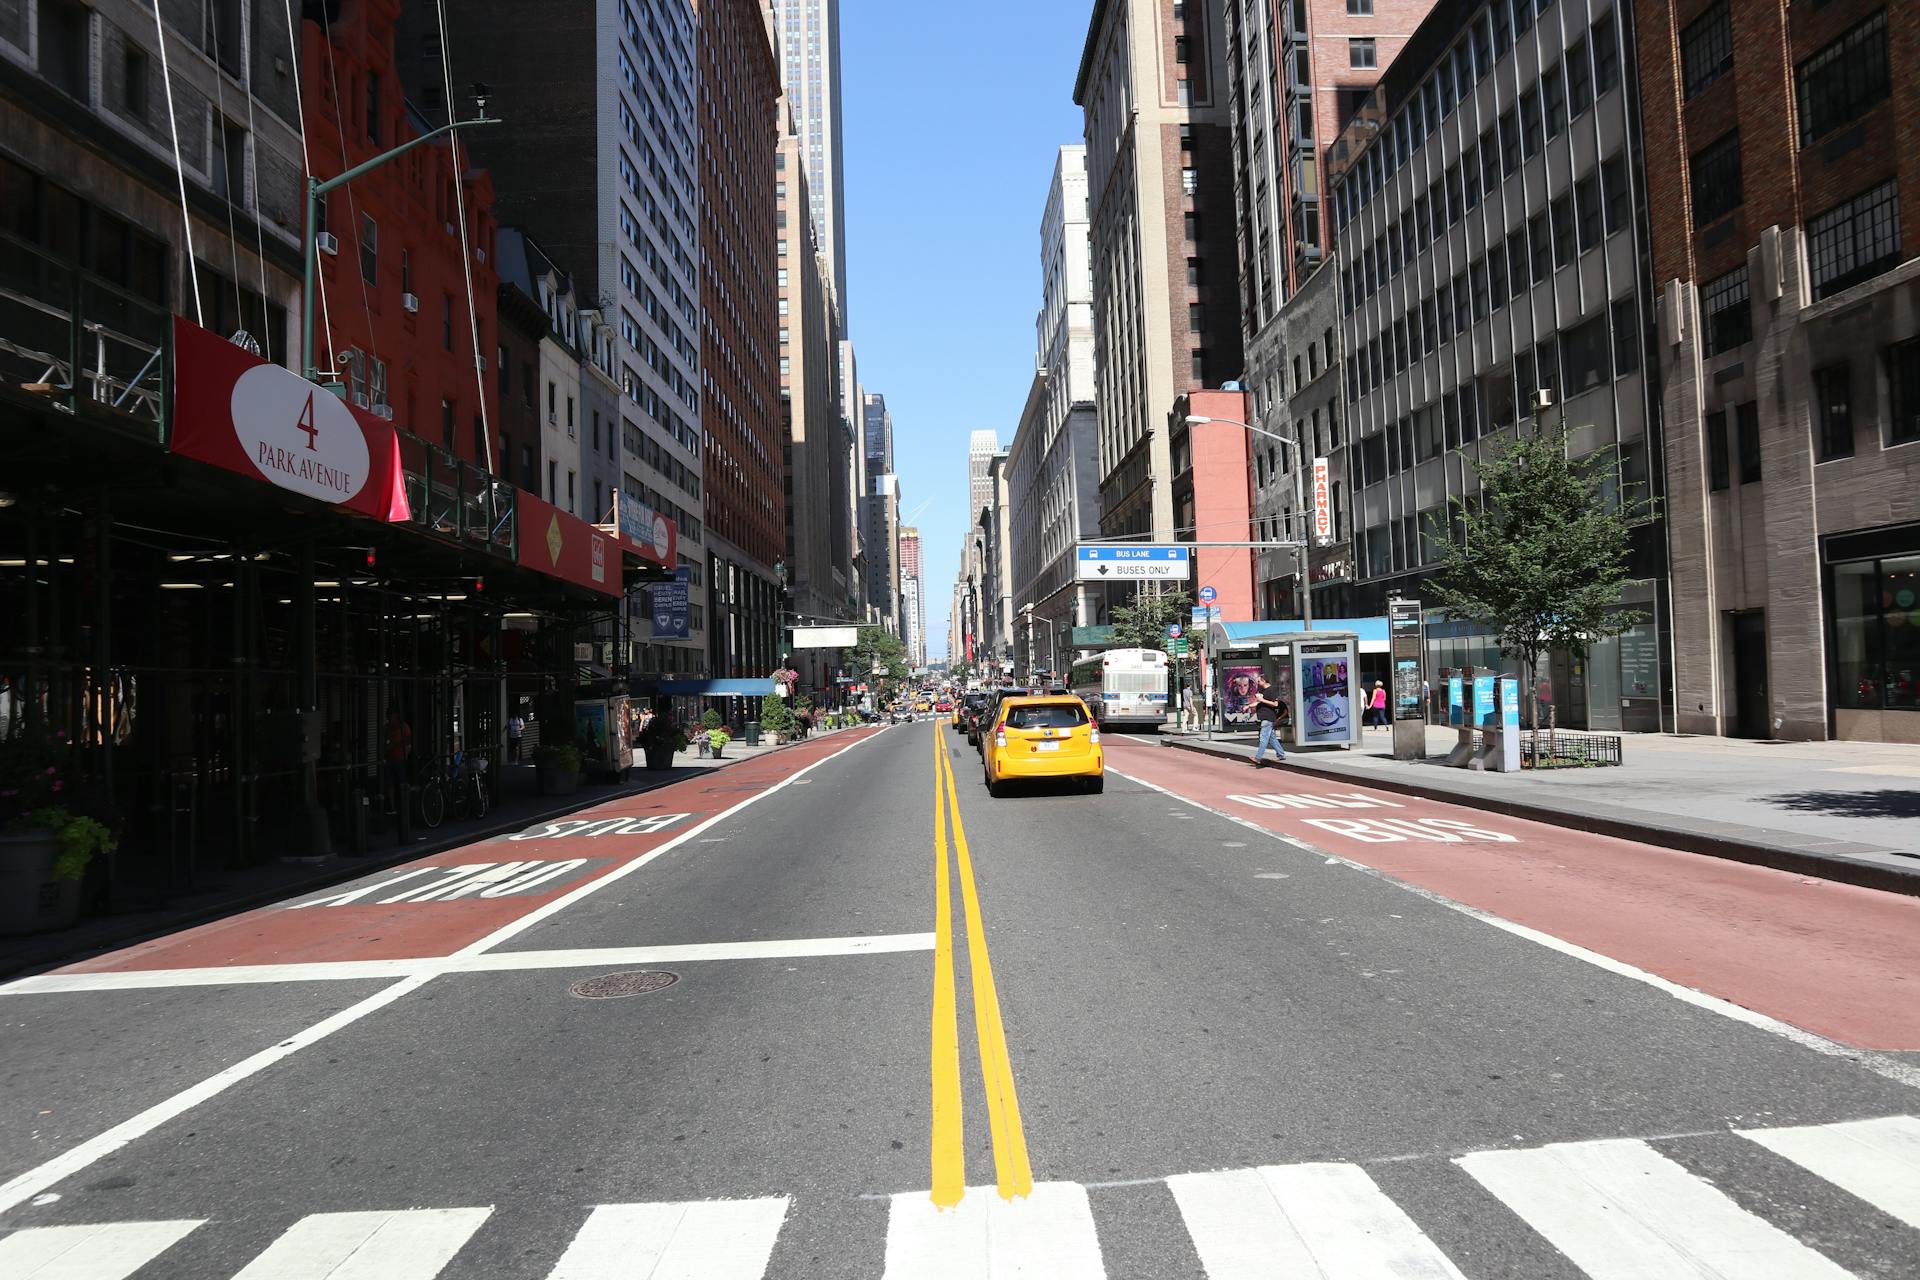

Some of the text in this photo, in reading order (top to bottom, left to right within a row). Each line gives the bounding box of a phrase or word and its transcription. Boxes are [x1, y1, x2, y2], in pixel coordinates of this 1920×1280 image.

[296, 389, 319, 452] 4
[258, 441, 350, 494] PARK AVENUE
[1315, 465, 1329, 534] PHARMACY
[1116, 550, 1150, 558] BUS LANE
[1117, 565, 1171, 575] BUSES ONLY
[1225, 793, 1407, 809] ONLY
[508, 812, 692, 841] BUS
[1300, 818, 1521, 843] BUS
[287, 858, 588, 910] ONLY
